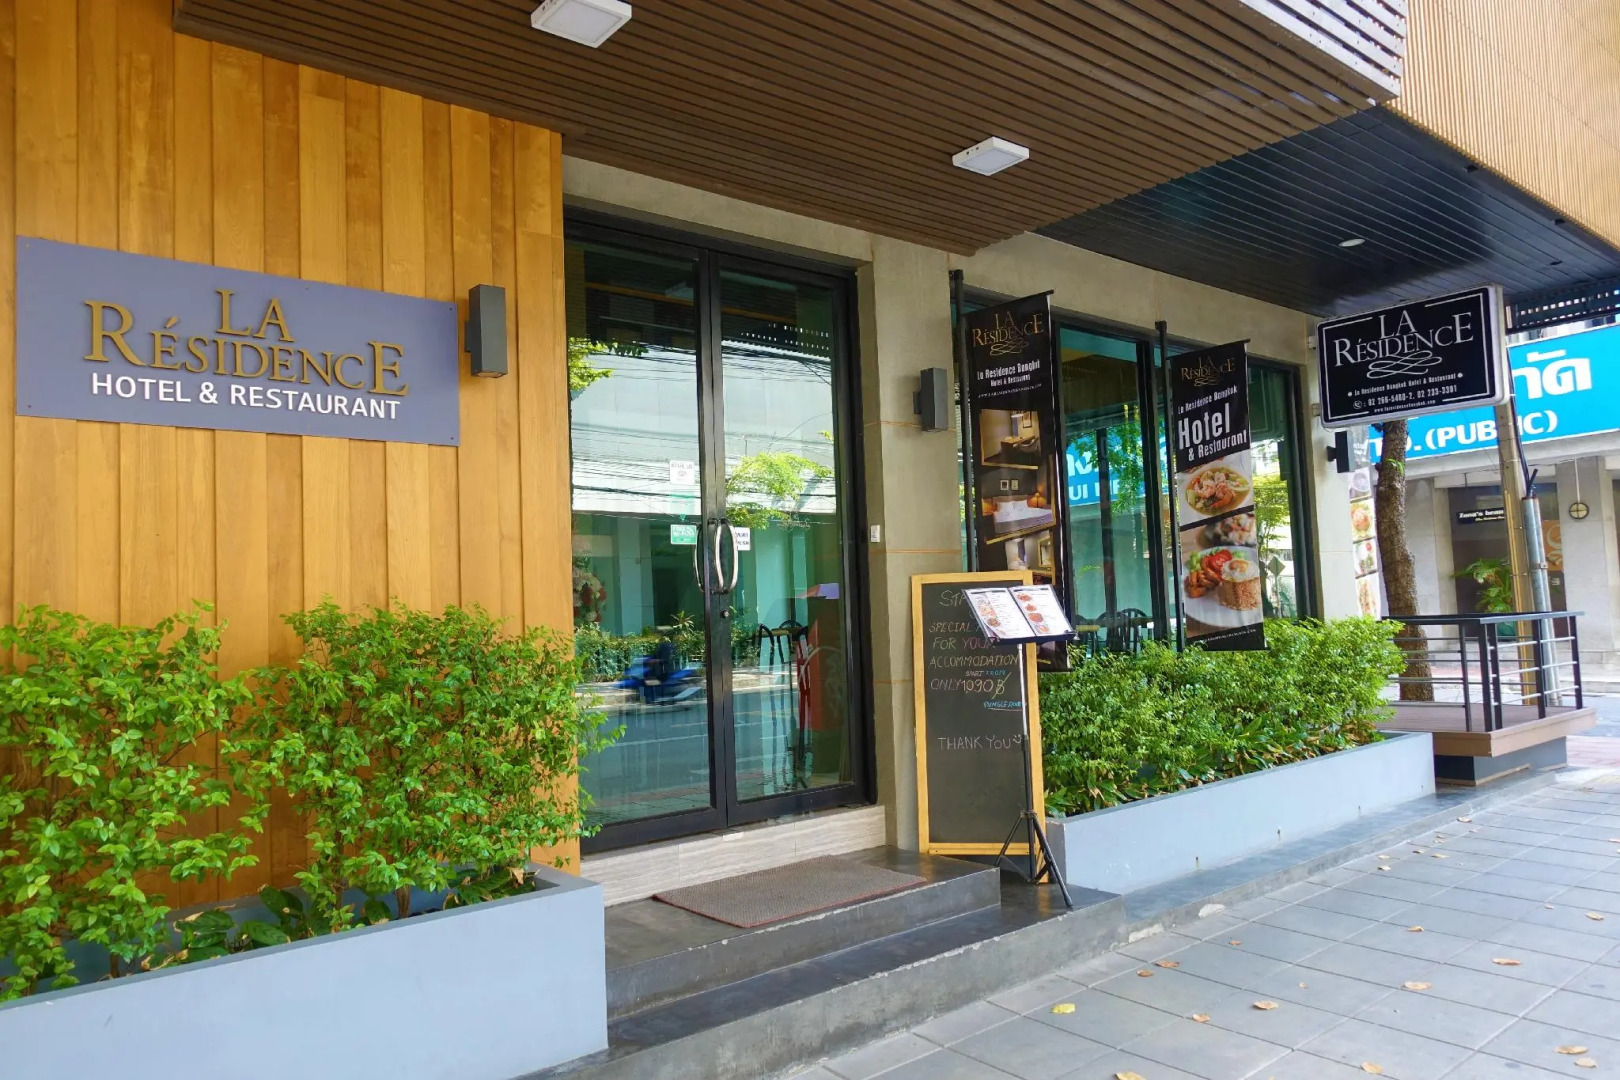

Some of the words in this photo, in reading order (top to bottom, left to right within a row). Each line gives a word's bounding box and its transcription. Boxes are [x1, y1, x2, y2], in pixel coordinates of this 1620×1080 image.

[215, 288, 295, 343] LA
[995, 310, 1016, 330] LA
[1378, 309, 1418, 340] LA
[985, 365, 1016, 379] Residence
[91, 372, 192, 403] HOTEL
[199, 381, 219, 405] &
[229, 383, 401, 420] RESTAURANT
[1185, 395, 1212, 411] Residence
[1213, 384, 1238, 400] Bangkok
[1417, 390, 1425, 399] 02
[1178, 402, 1230, 450] Hotel
[1188, 447, 1195, 462] &
[1198, 429, 1247, 458] Restaurant
[929, 621, 973, 633] SPECIAL
[933, 636, 957, 650] FOR
[928, 653, 1019, 669] ACCOMMODATION
[930, 678, 962, 691] ONLY
[937, 736, 983, 750] THANK
[985, 734, 1011, 750] YOU
